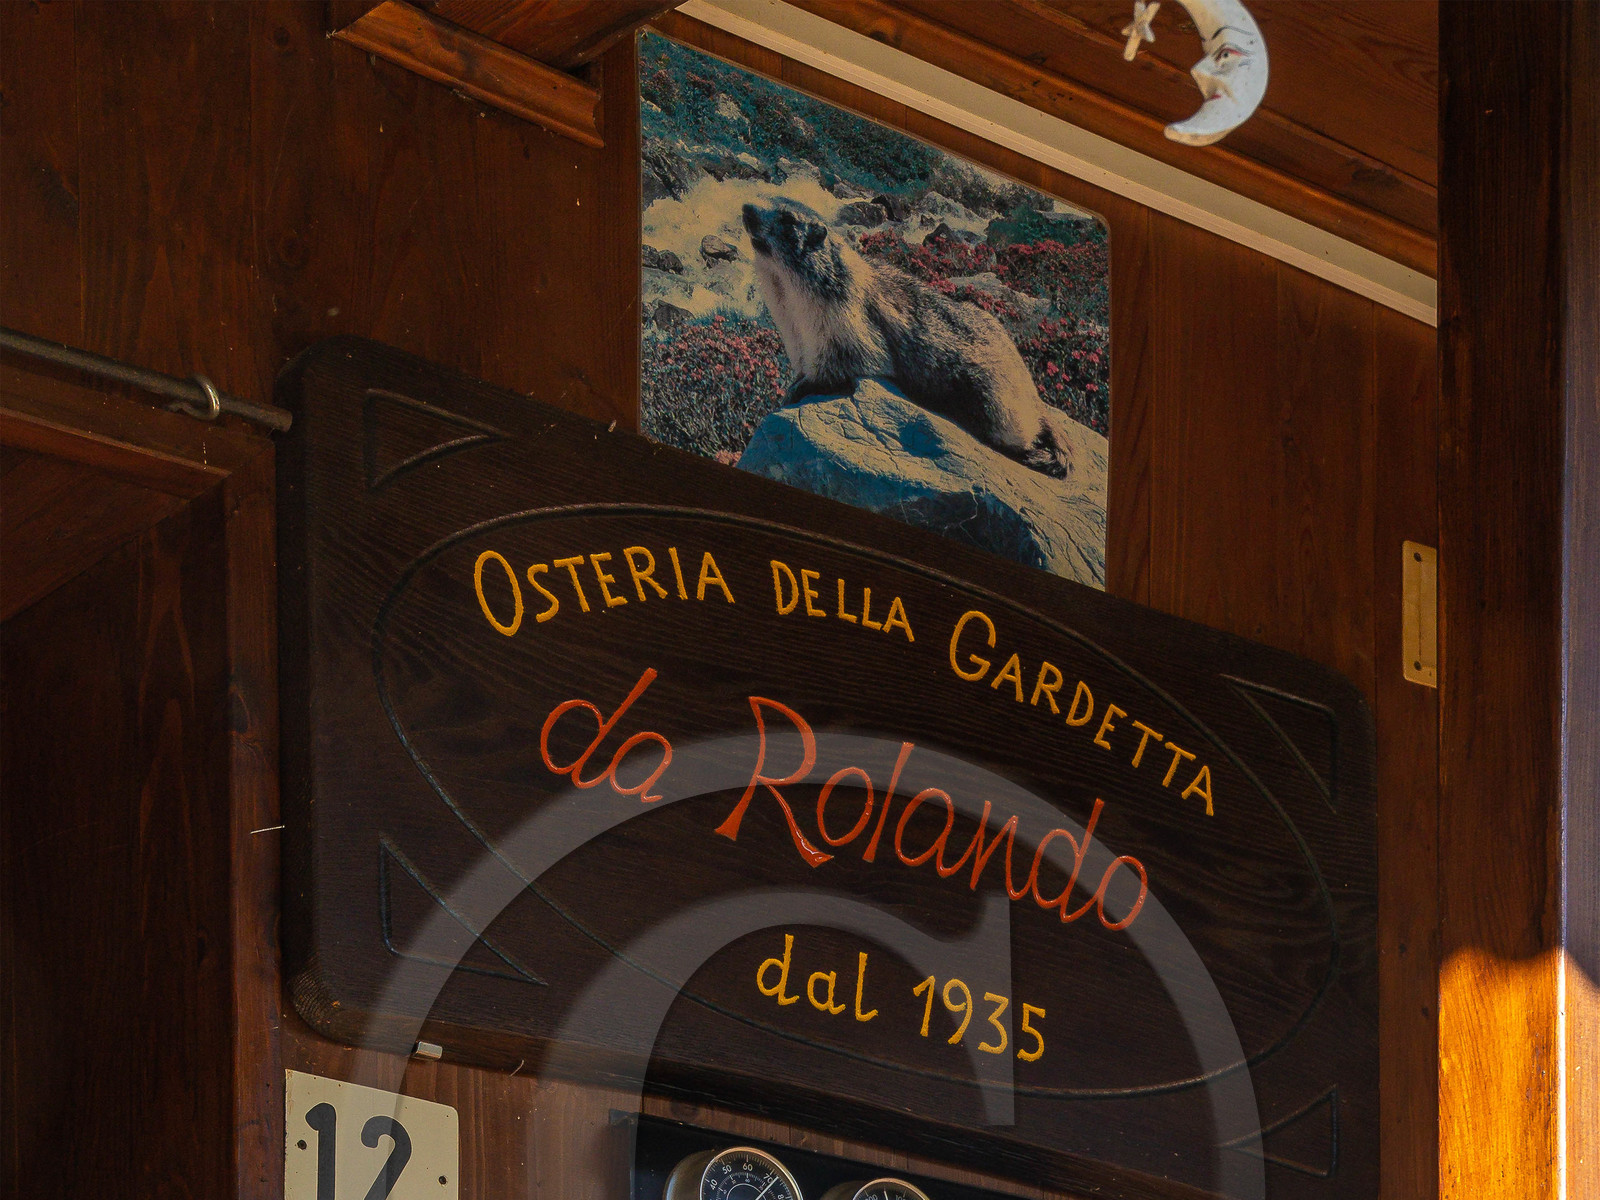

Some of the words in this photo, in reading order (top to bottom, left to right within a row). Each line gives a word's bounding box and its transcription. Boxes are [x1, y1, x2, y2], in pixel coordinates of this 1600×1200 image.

[474, 545, 736, 637] OSTERIA
[771, 559, 915, 642] DELLA
[949, 610, 1215, 817] GARDETTA
[540, 667, 673, 803] da
[715, 696, 1149, 932] Rolando
[756, 933, 878, 1022] dal
[912, 974, 1046, 1063] 1935
[711, 1179, 717, 1189] 40
[722, 1165, 731, 1174] 50
[743, 1163, 752, 1171] 60
